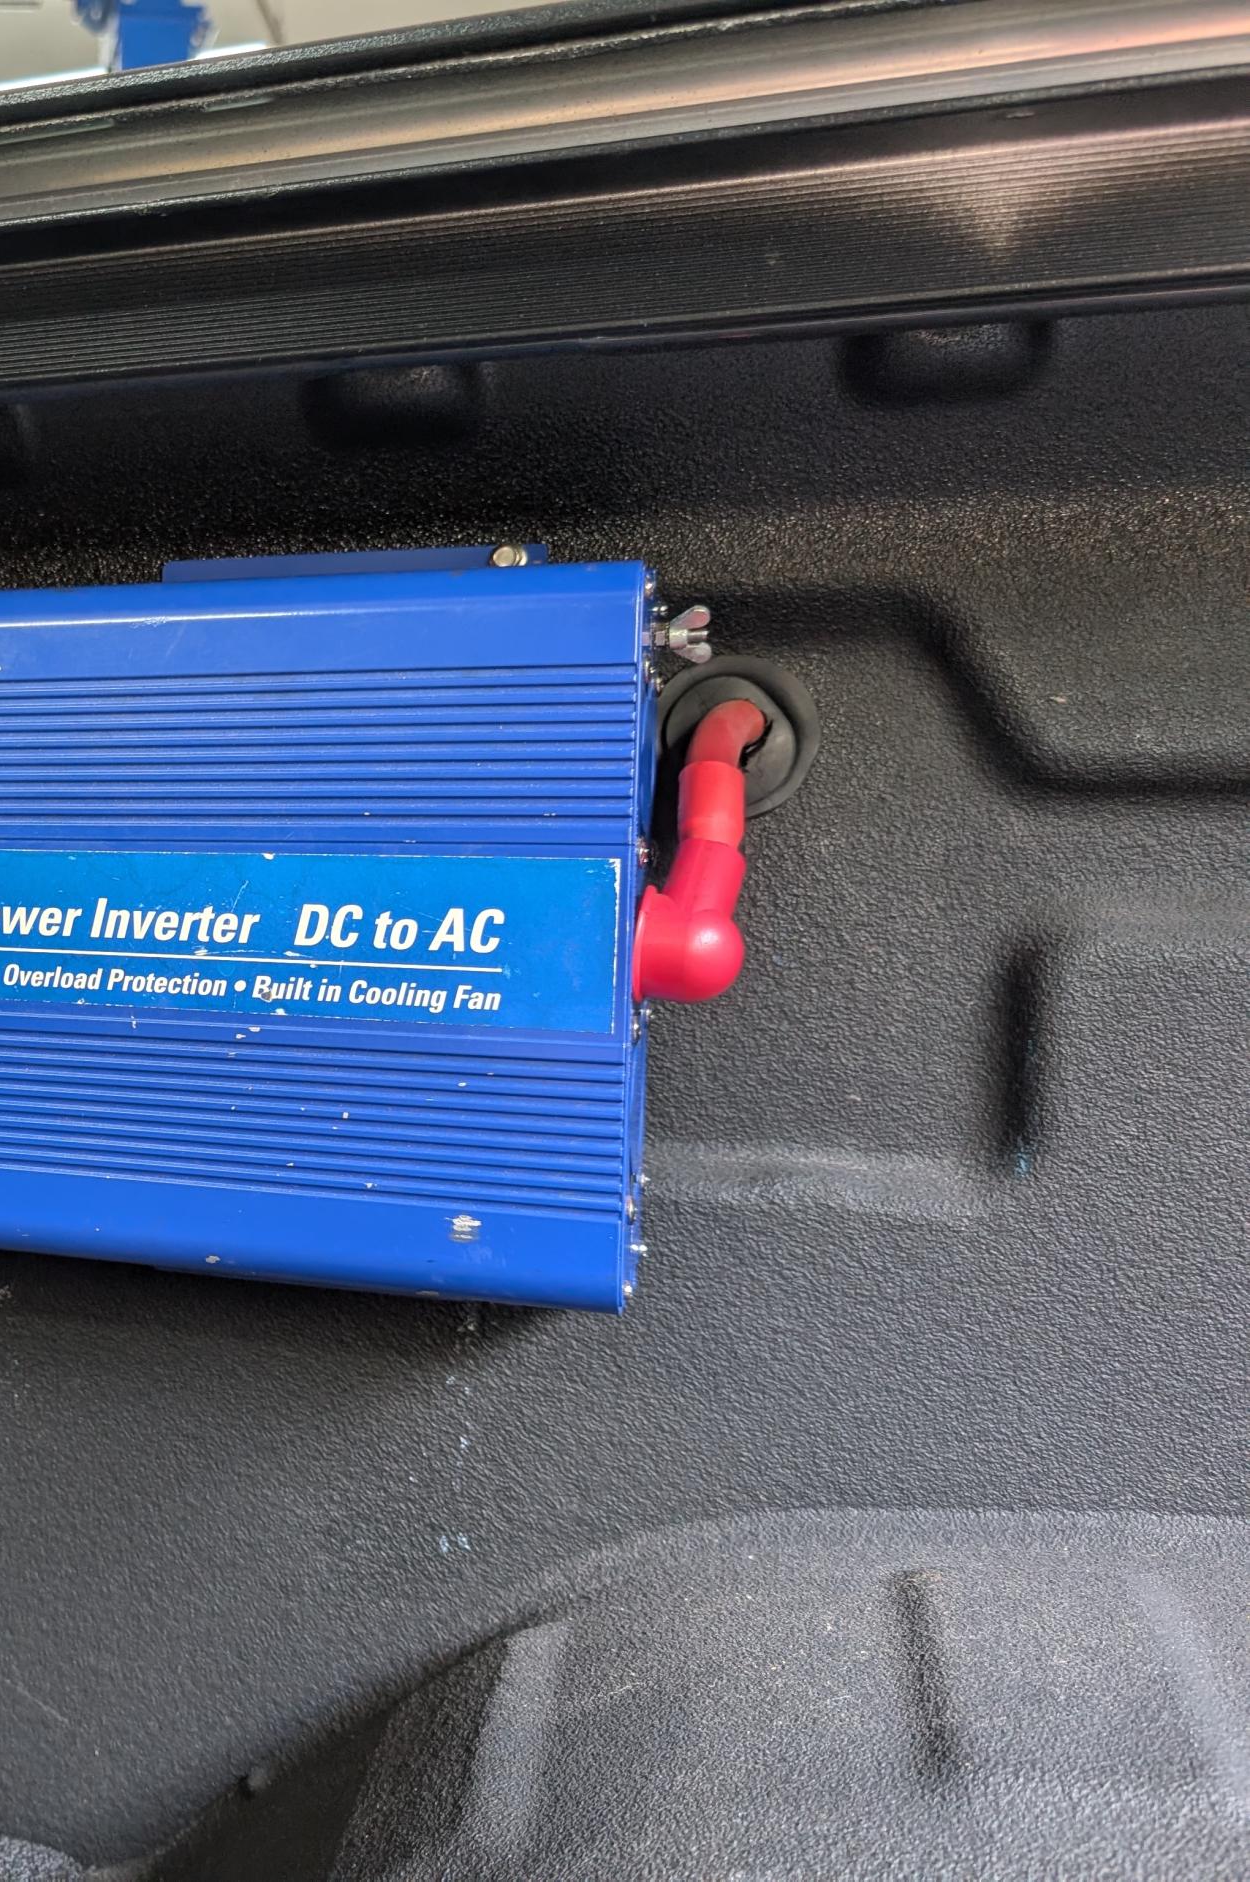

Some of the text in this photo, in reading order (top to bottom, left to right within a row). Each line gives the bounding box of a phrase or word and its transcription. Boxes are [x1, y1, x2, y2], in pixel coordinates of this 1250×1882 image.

[90, 897, 261, 944] Inverter
[293, 903, 363, 948] DC
[373, 911, 418, 951] to
[428, 907, 505, 954] AC
[3, 963, 103, 990] Overload
[107, 968, 228, 997] Protection
[252, 975, 313, 1003] Built
[317, 978, 342, 1003] in
[348, 979, 448, 1014] Cooling
[453, 984, 501, 1011] Fan
